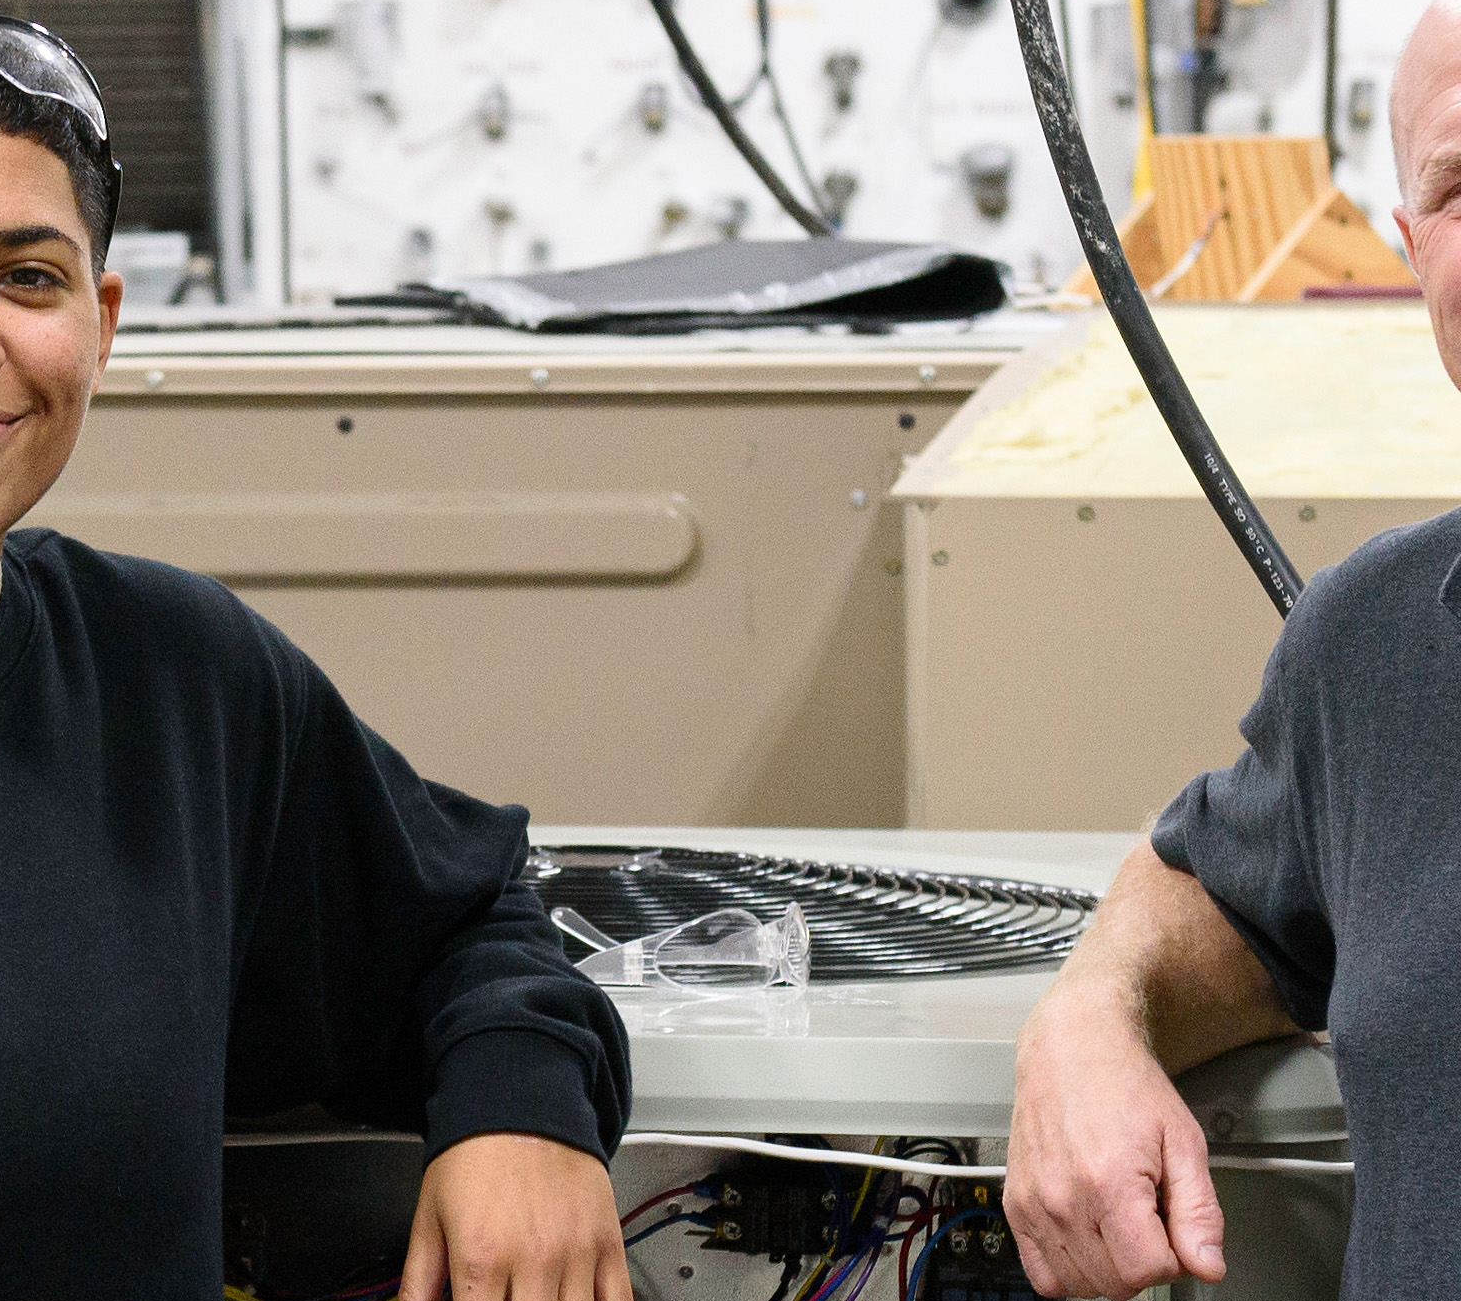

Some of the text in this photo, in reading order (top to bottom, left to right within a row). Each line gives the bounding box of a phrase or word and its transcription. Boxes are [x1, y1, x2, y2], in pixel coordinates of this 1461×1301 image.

[1204, 452, 1219, 474] 10/4
[1218, 478, 1237, 506] TYPE
[1234, 507, 1246, 523] SO
